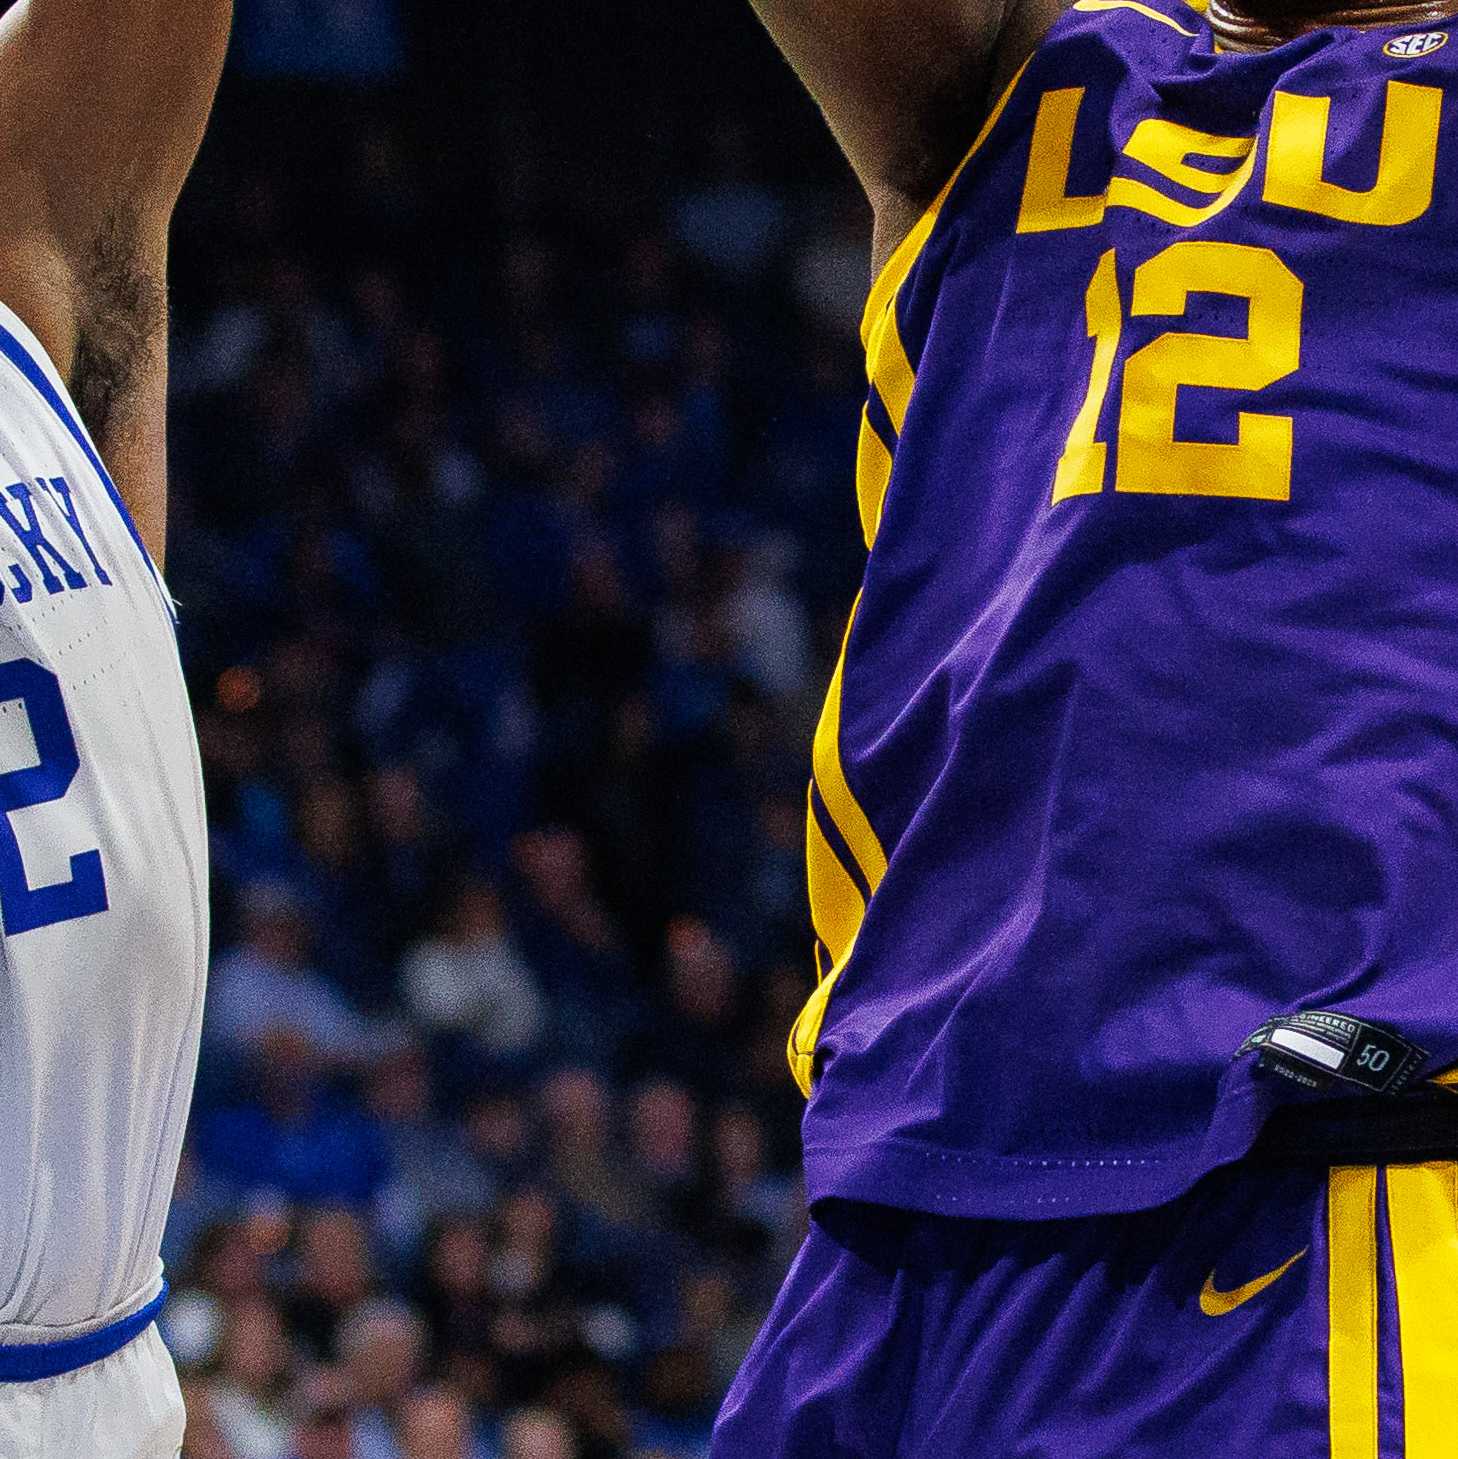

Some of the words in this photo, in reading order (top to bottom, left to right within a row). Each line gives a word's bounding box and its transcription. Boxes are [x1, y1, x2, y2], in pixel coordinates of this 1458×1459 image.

[1389, 31, 1444, 55] SEC
[1016, 79, 1444, 234] LSU
[1051, 240, 1305, 506] 12
[1356, 1043, 1391, 1072] 50
